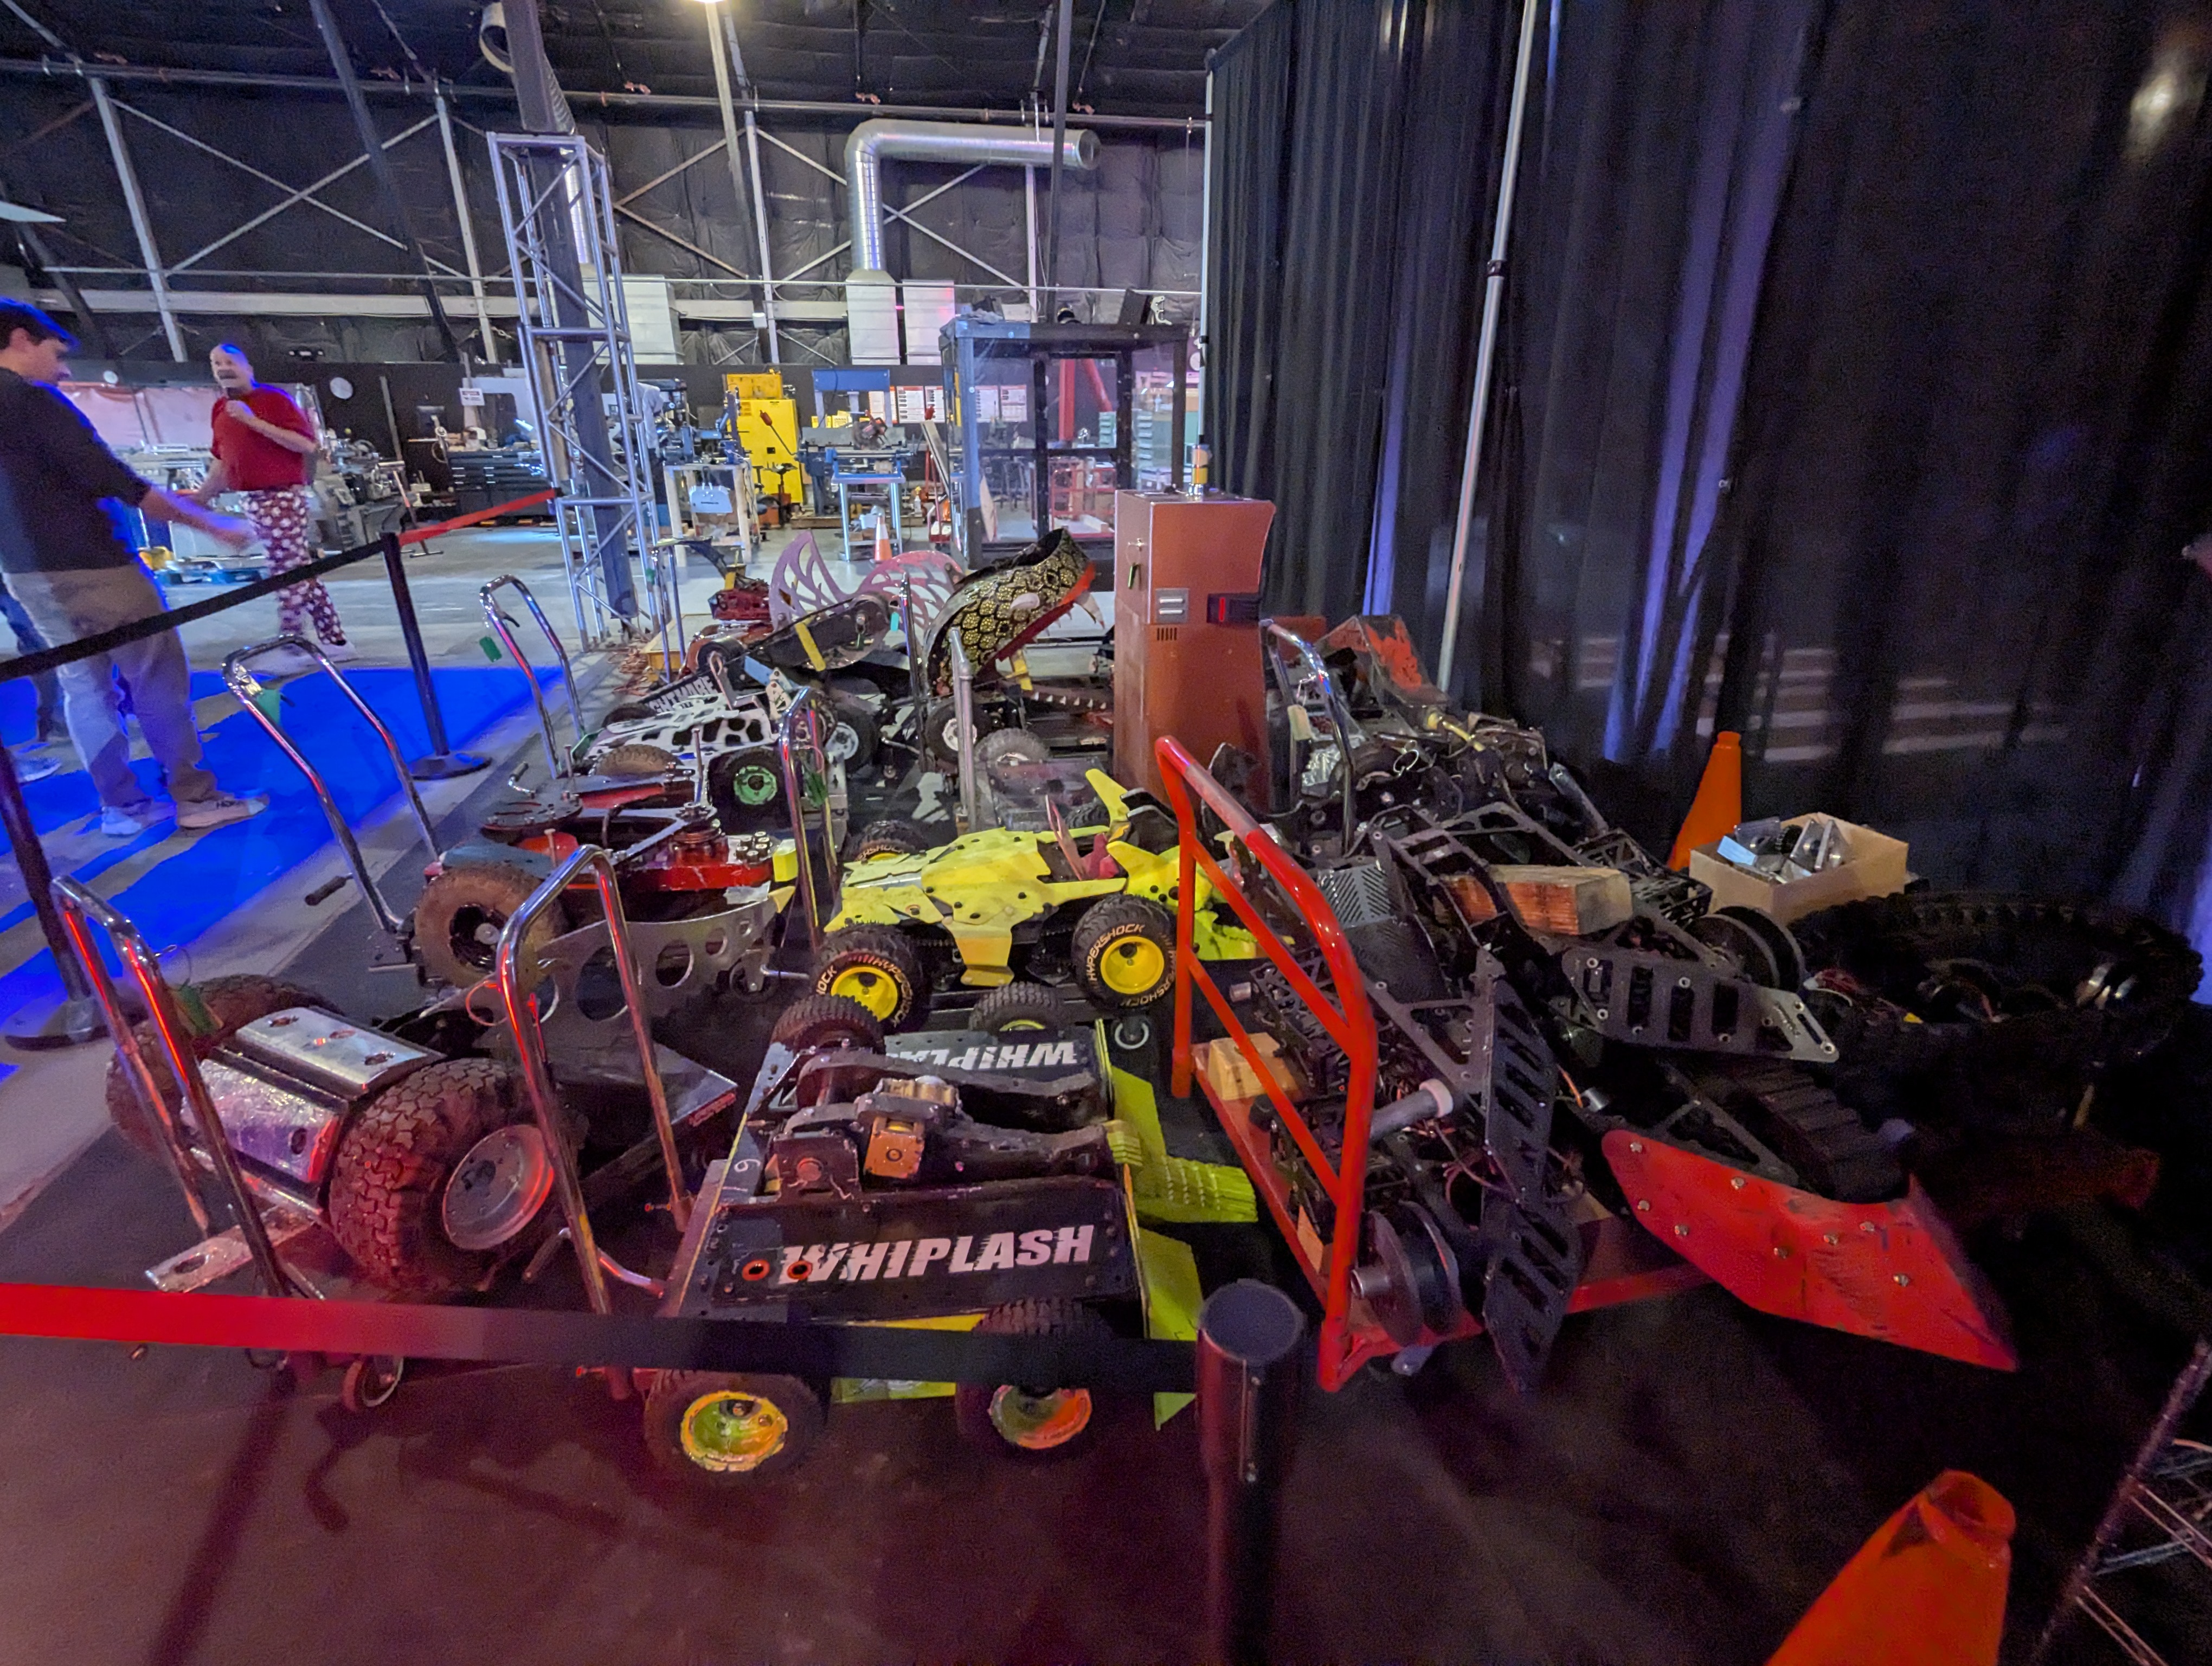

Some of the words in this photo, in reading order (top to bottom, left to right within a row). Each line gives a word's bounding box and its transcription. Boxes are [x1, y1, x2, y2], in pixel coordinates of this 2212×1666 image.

[649, 676, 719, 713] GHTMARE
[1086, 924, 1146, 982] HYPERSHOCK
[886, 1041, 1078, 1071] WHIPL
[779, 1225, 1094, 1285] WHIPLASH
